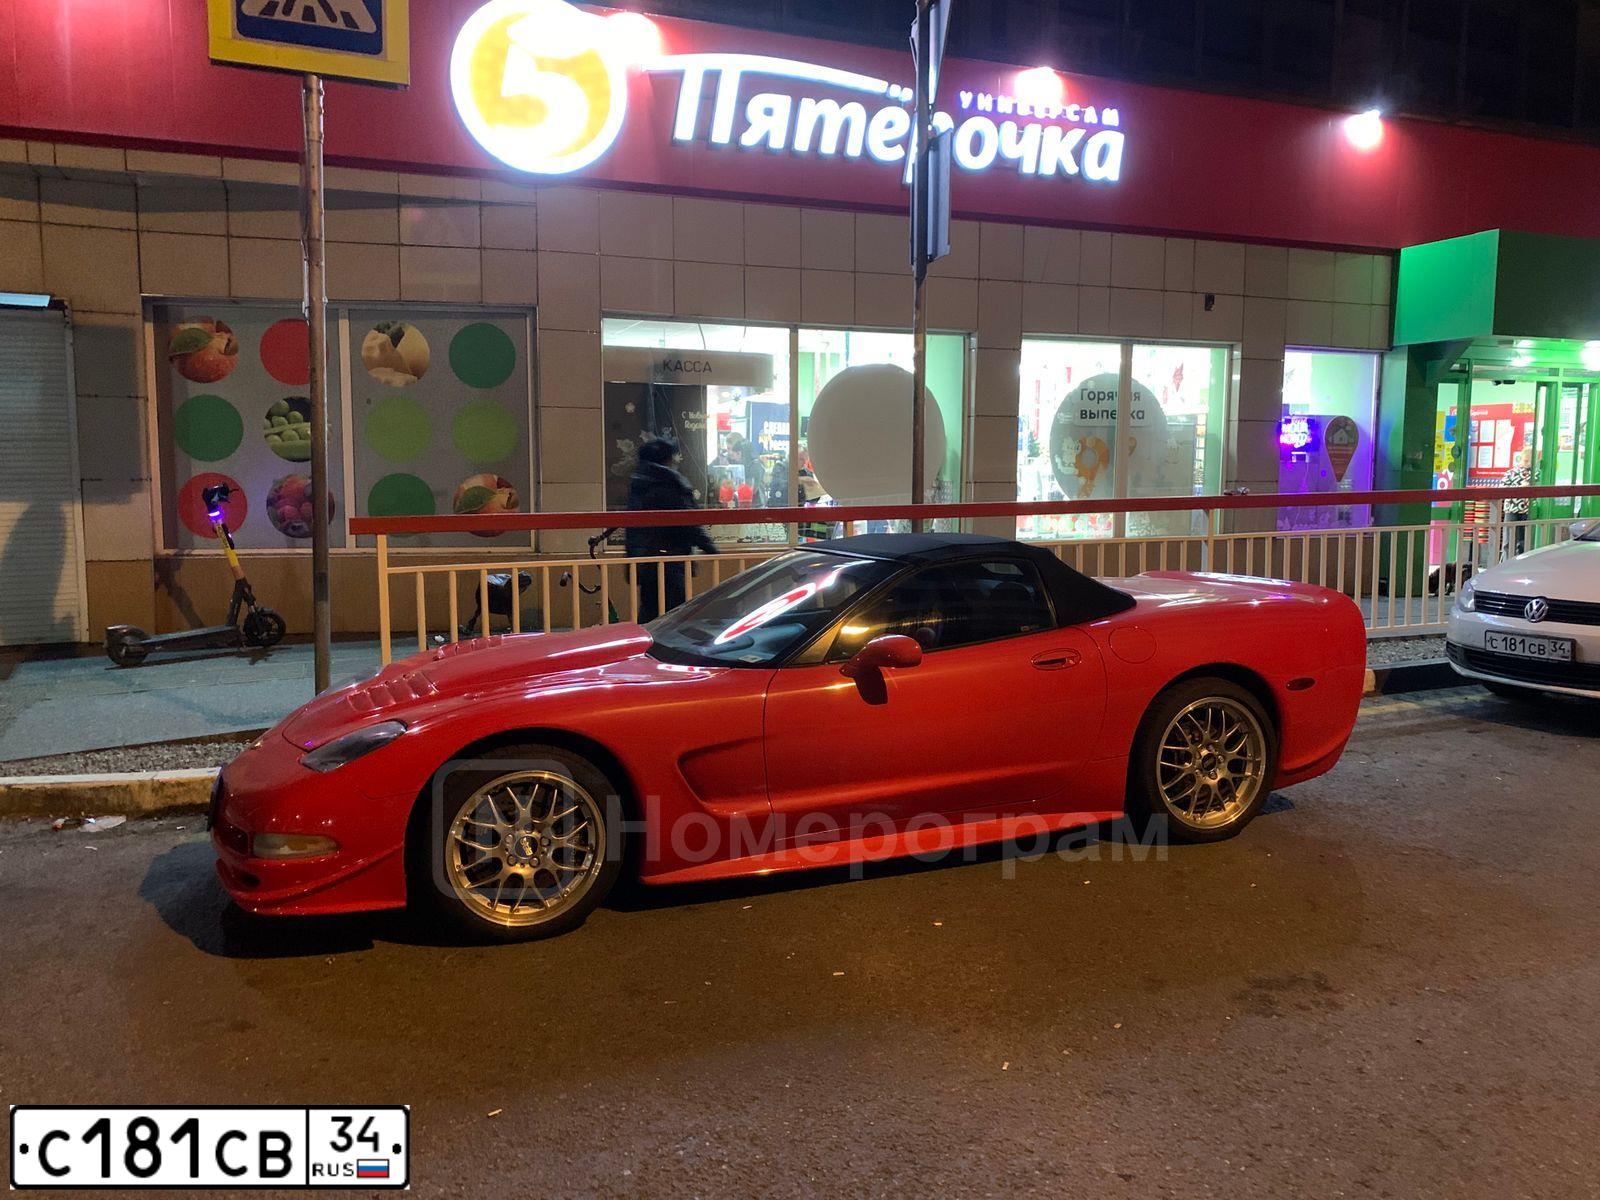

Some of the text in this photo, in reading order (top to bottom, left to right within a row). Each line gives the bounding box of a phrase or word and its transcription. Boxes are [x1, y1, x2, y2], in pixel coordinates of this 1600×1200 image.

[663, 359, 712, 373] КАССА
[1080, 388, 1141, 404] Горяя
[1080, 409, 1145, 420] выпека
